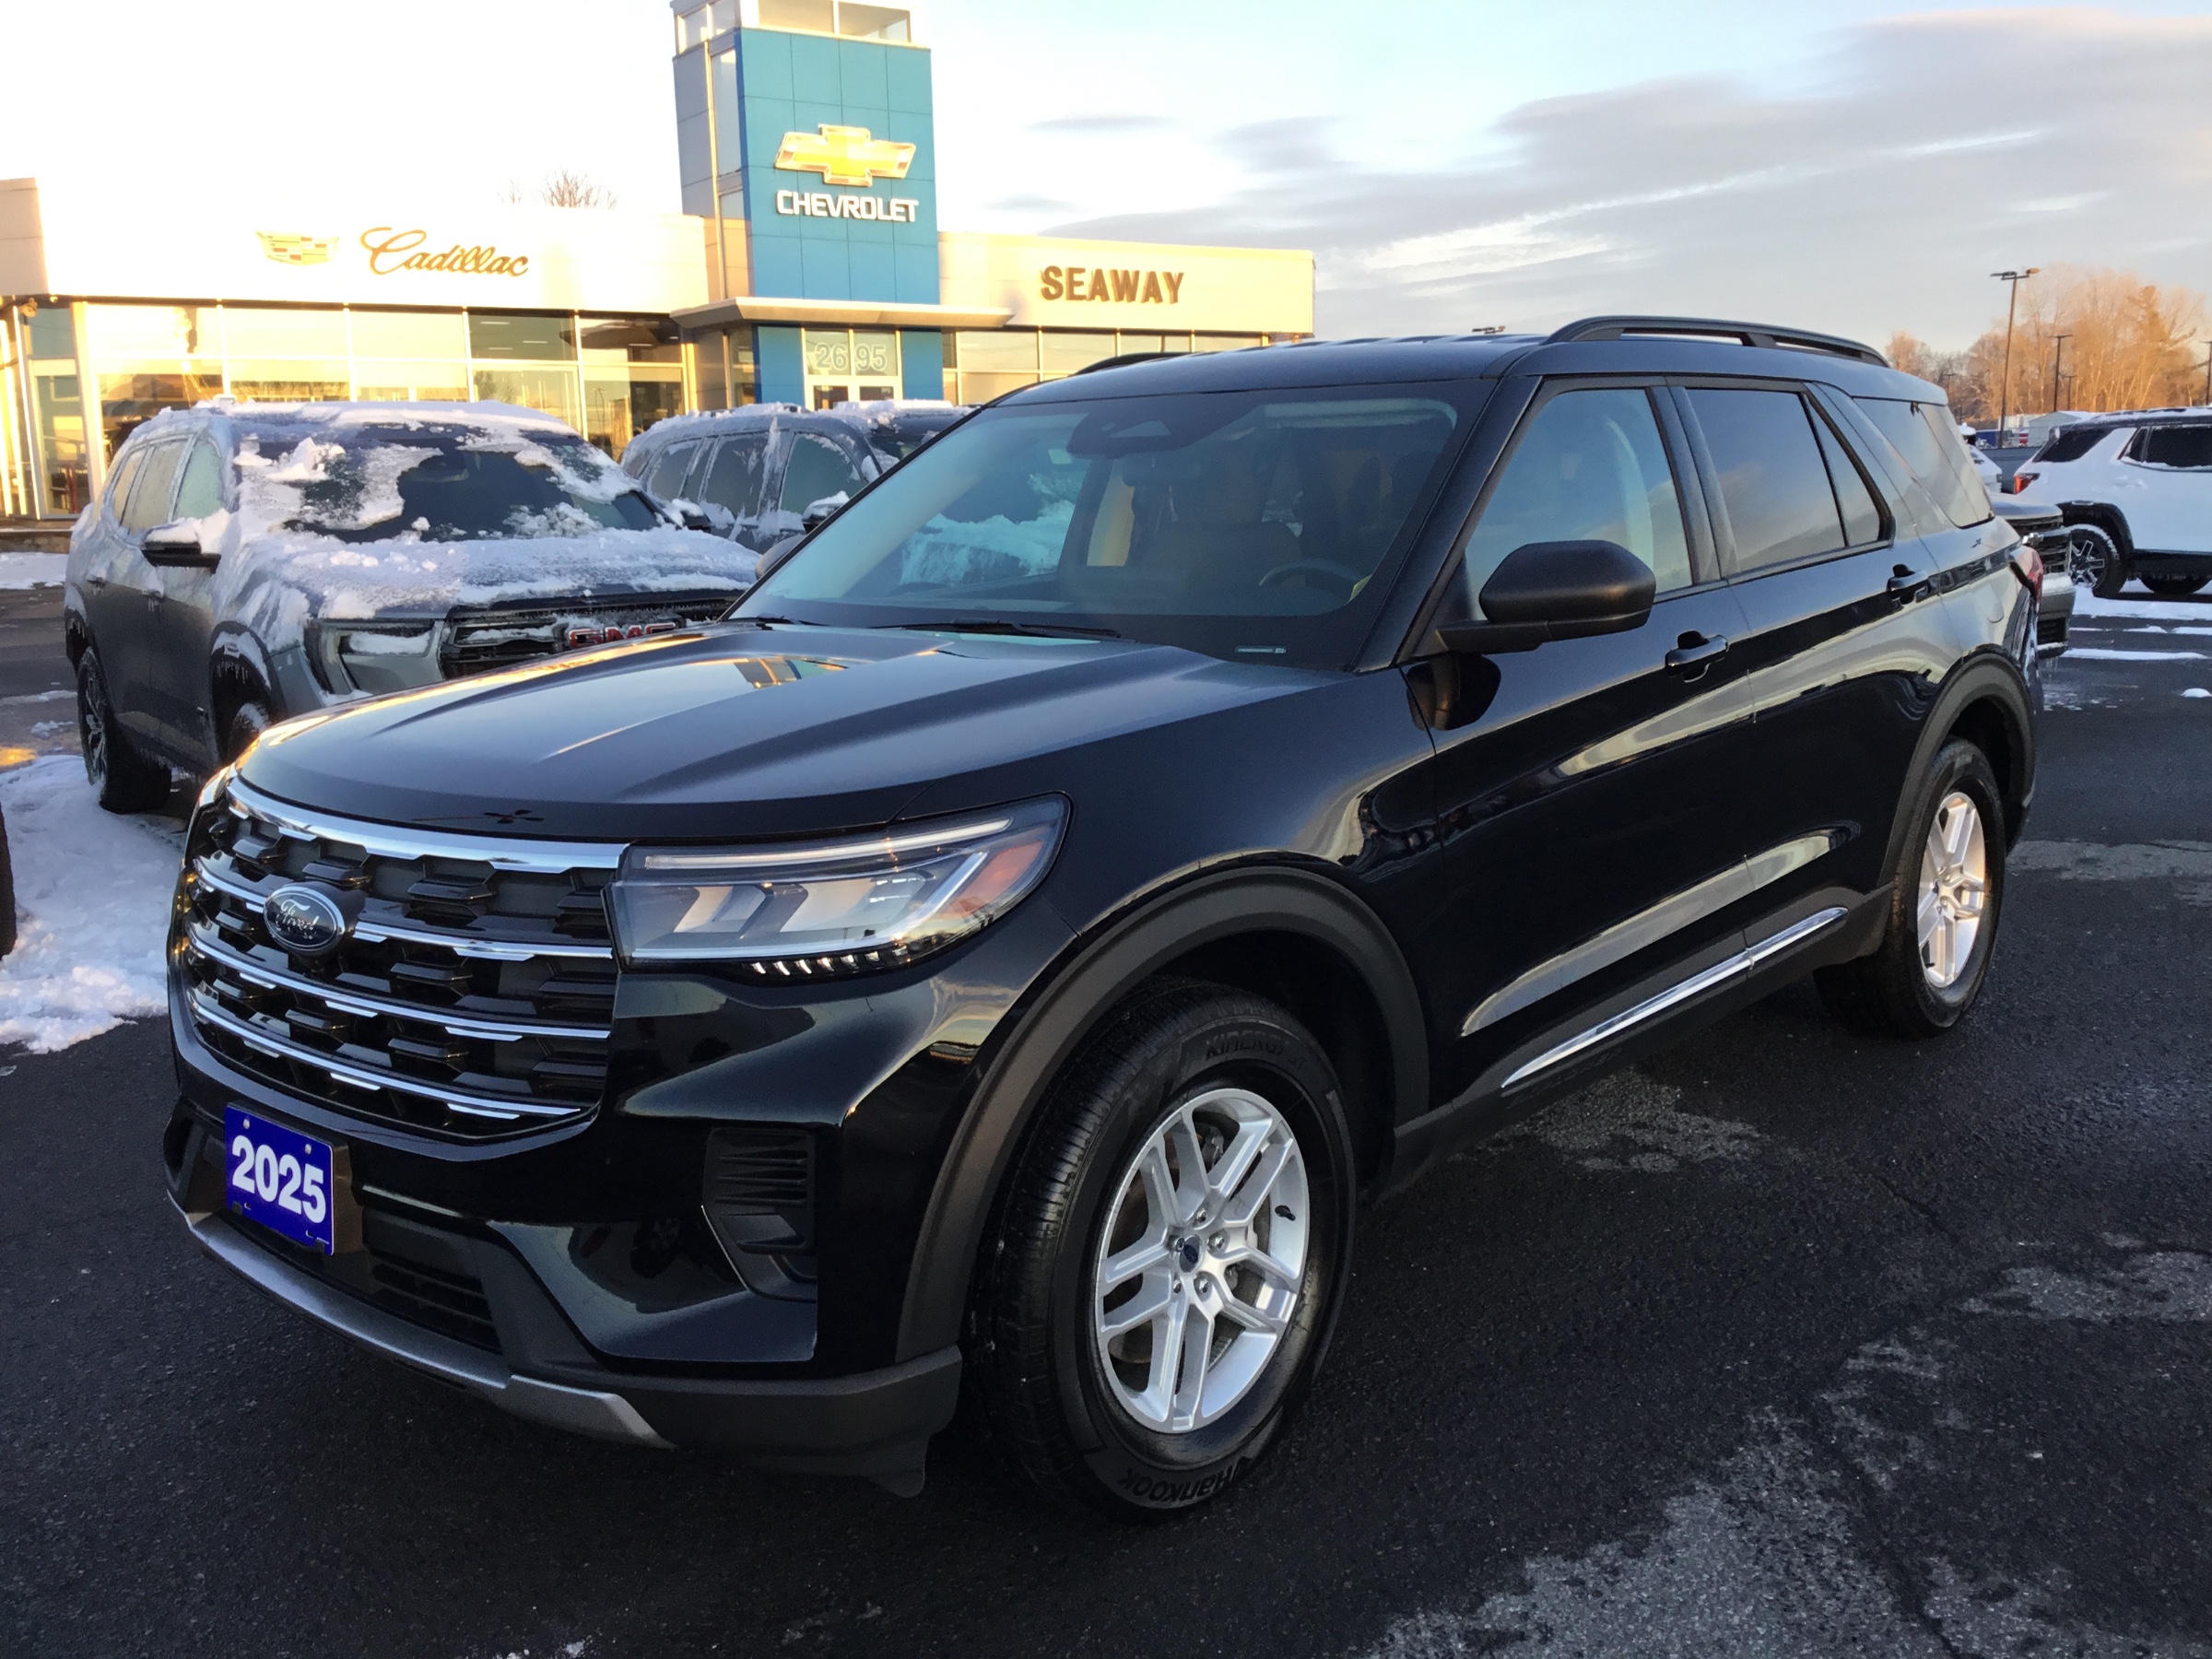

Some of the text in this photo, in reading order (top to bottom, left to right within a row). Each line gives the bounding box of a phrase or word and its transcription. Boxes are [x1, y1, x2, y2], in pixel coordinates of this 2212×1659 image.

[776, 189, 920, 223] CHEVROLET
[360, 227, 529, 276] Cadillac
[1041, 265, 1185, 304] SEAWAY
[232, 1135, 326, 1224] 2025
